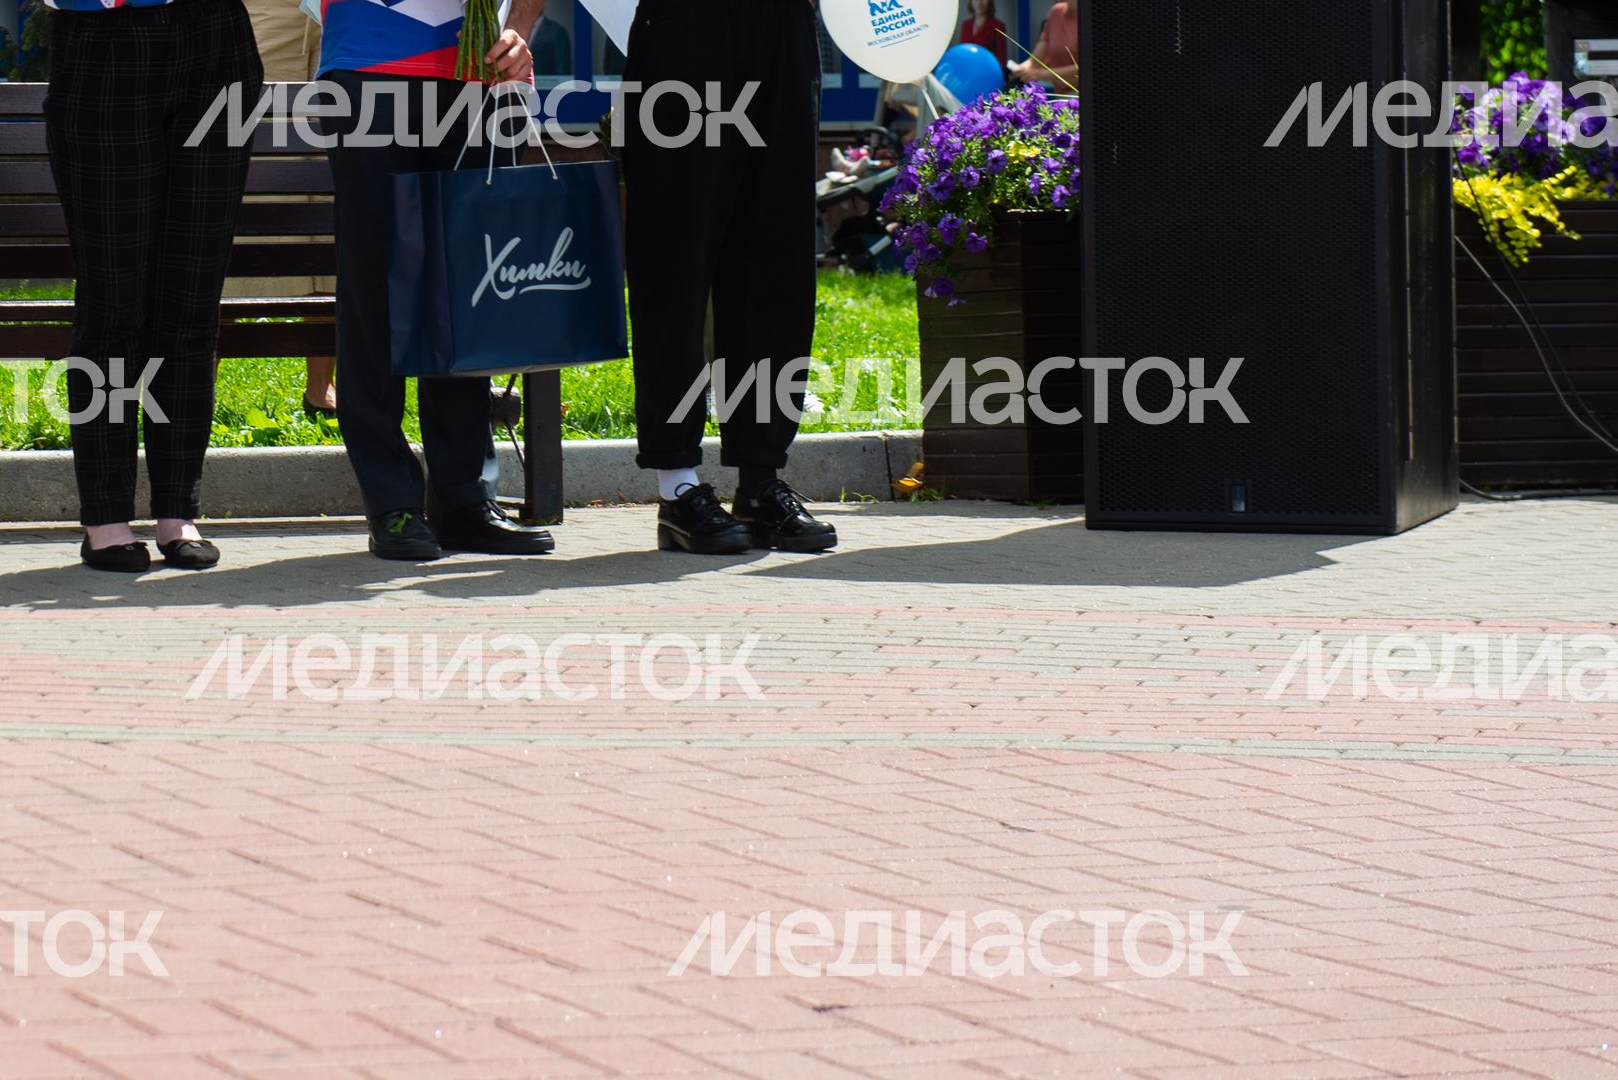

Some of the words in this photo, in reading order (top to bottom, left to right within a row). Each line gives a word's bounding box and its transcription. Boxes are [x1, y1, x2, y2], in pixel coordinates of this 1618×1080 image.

[871, 8, 913, 26] ЕДИНАЯ
[874, 16, 916, 36] РОССИЯ
[471, 226, 591, 308] Химки
